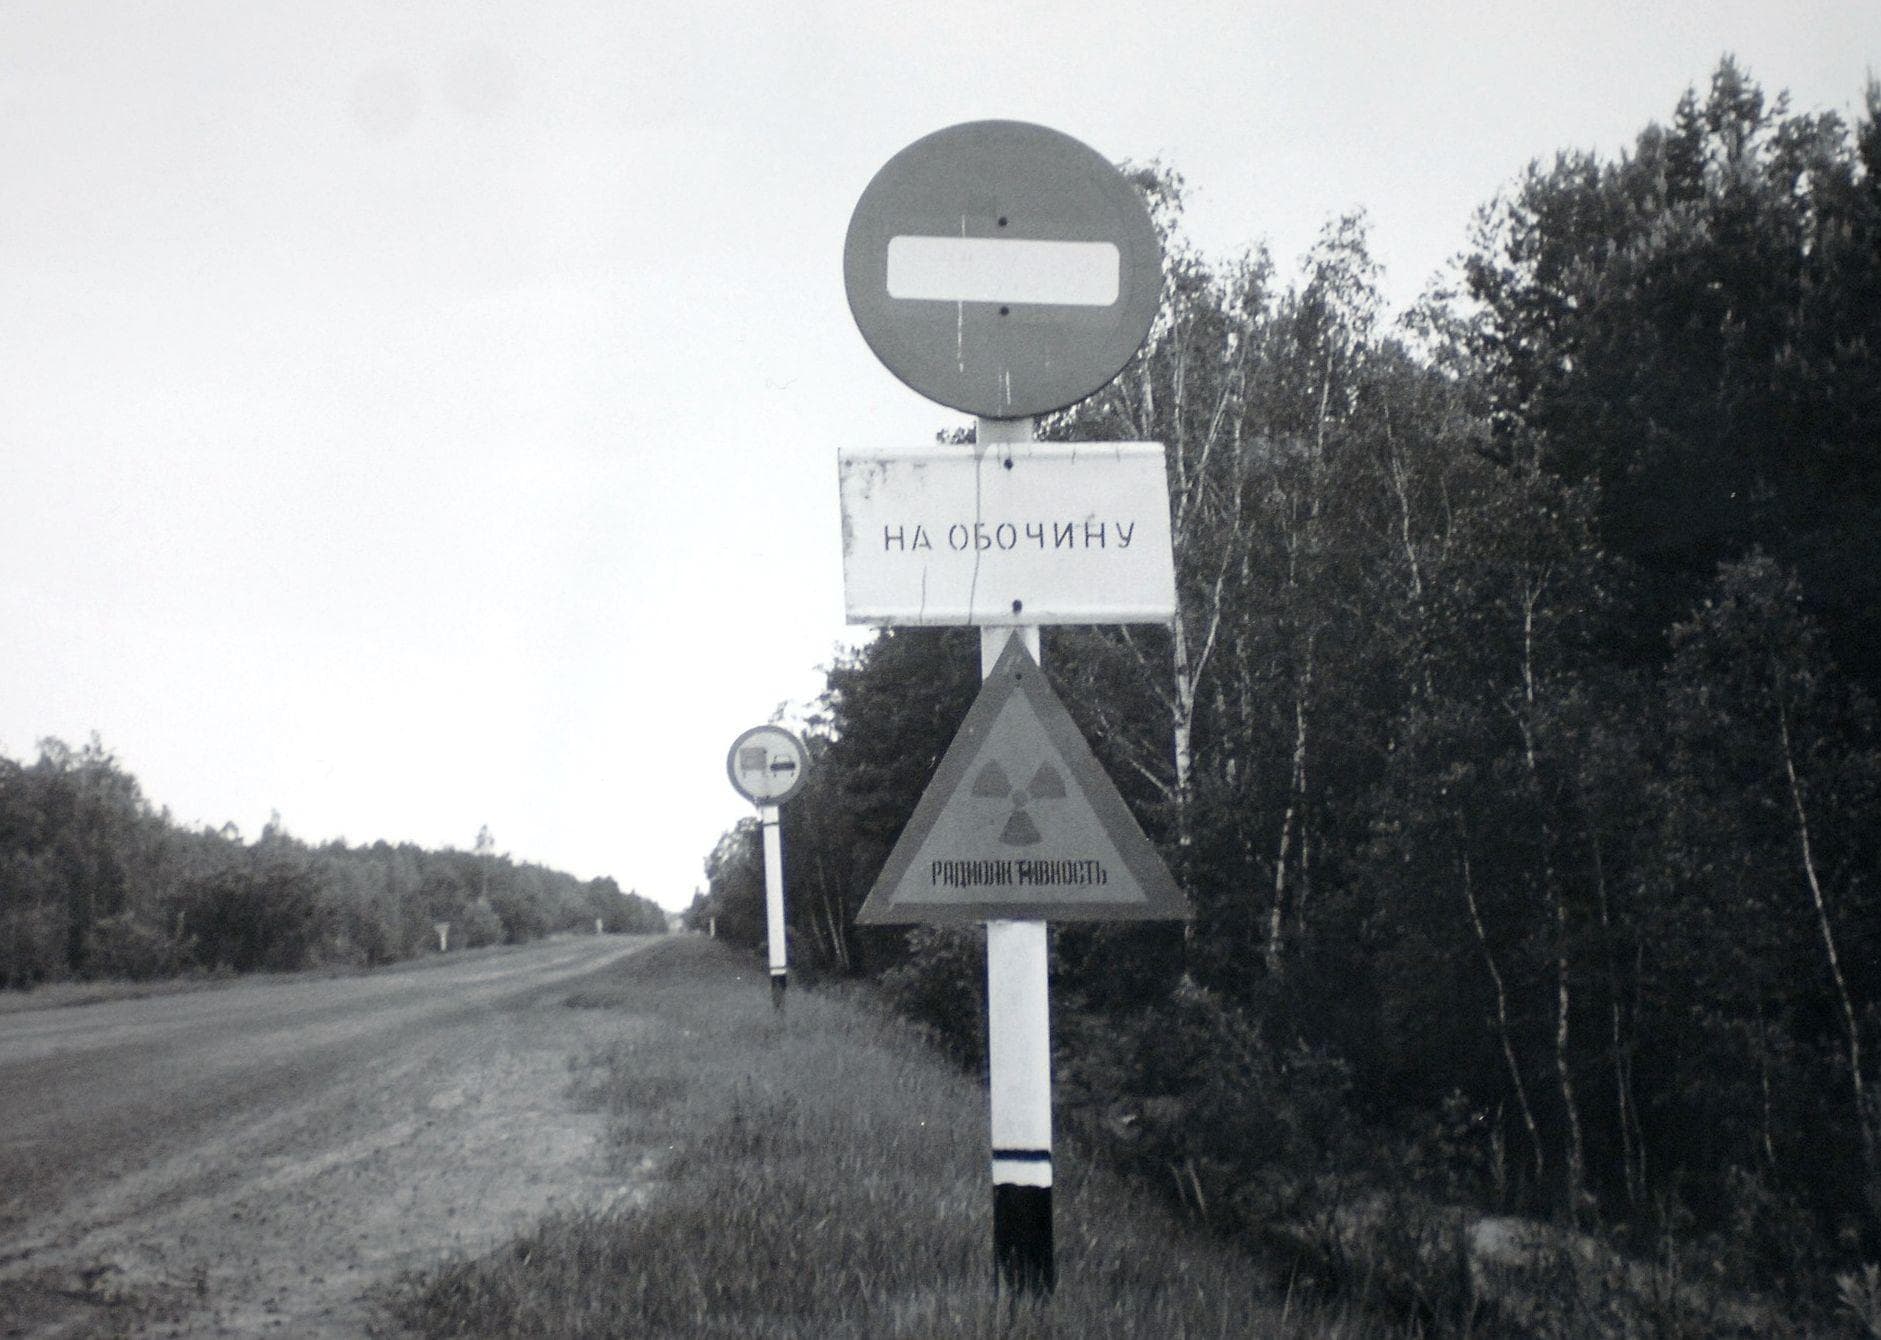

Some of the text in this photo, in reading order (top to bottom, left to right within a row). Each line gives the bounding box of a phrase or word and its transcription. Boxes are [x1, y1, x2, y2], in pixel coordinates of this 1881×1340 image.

[884, 522, 1135, 551] НА ОБОЧИНУ
[931, 859, 1108, 888] РАДИОАКТИВНОСТЬ
